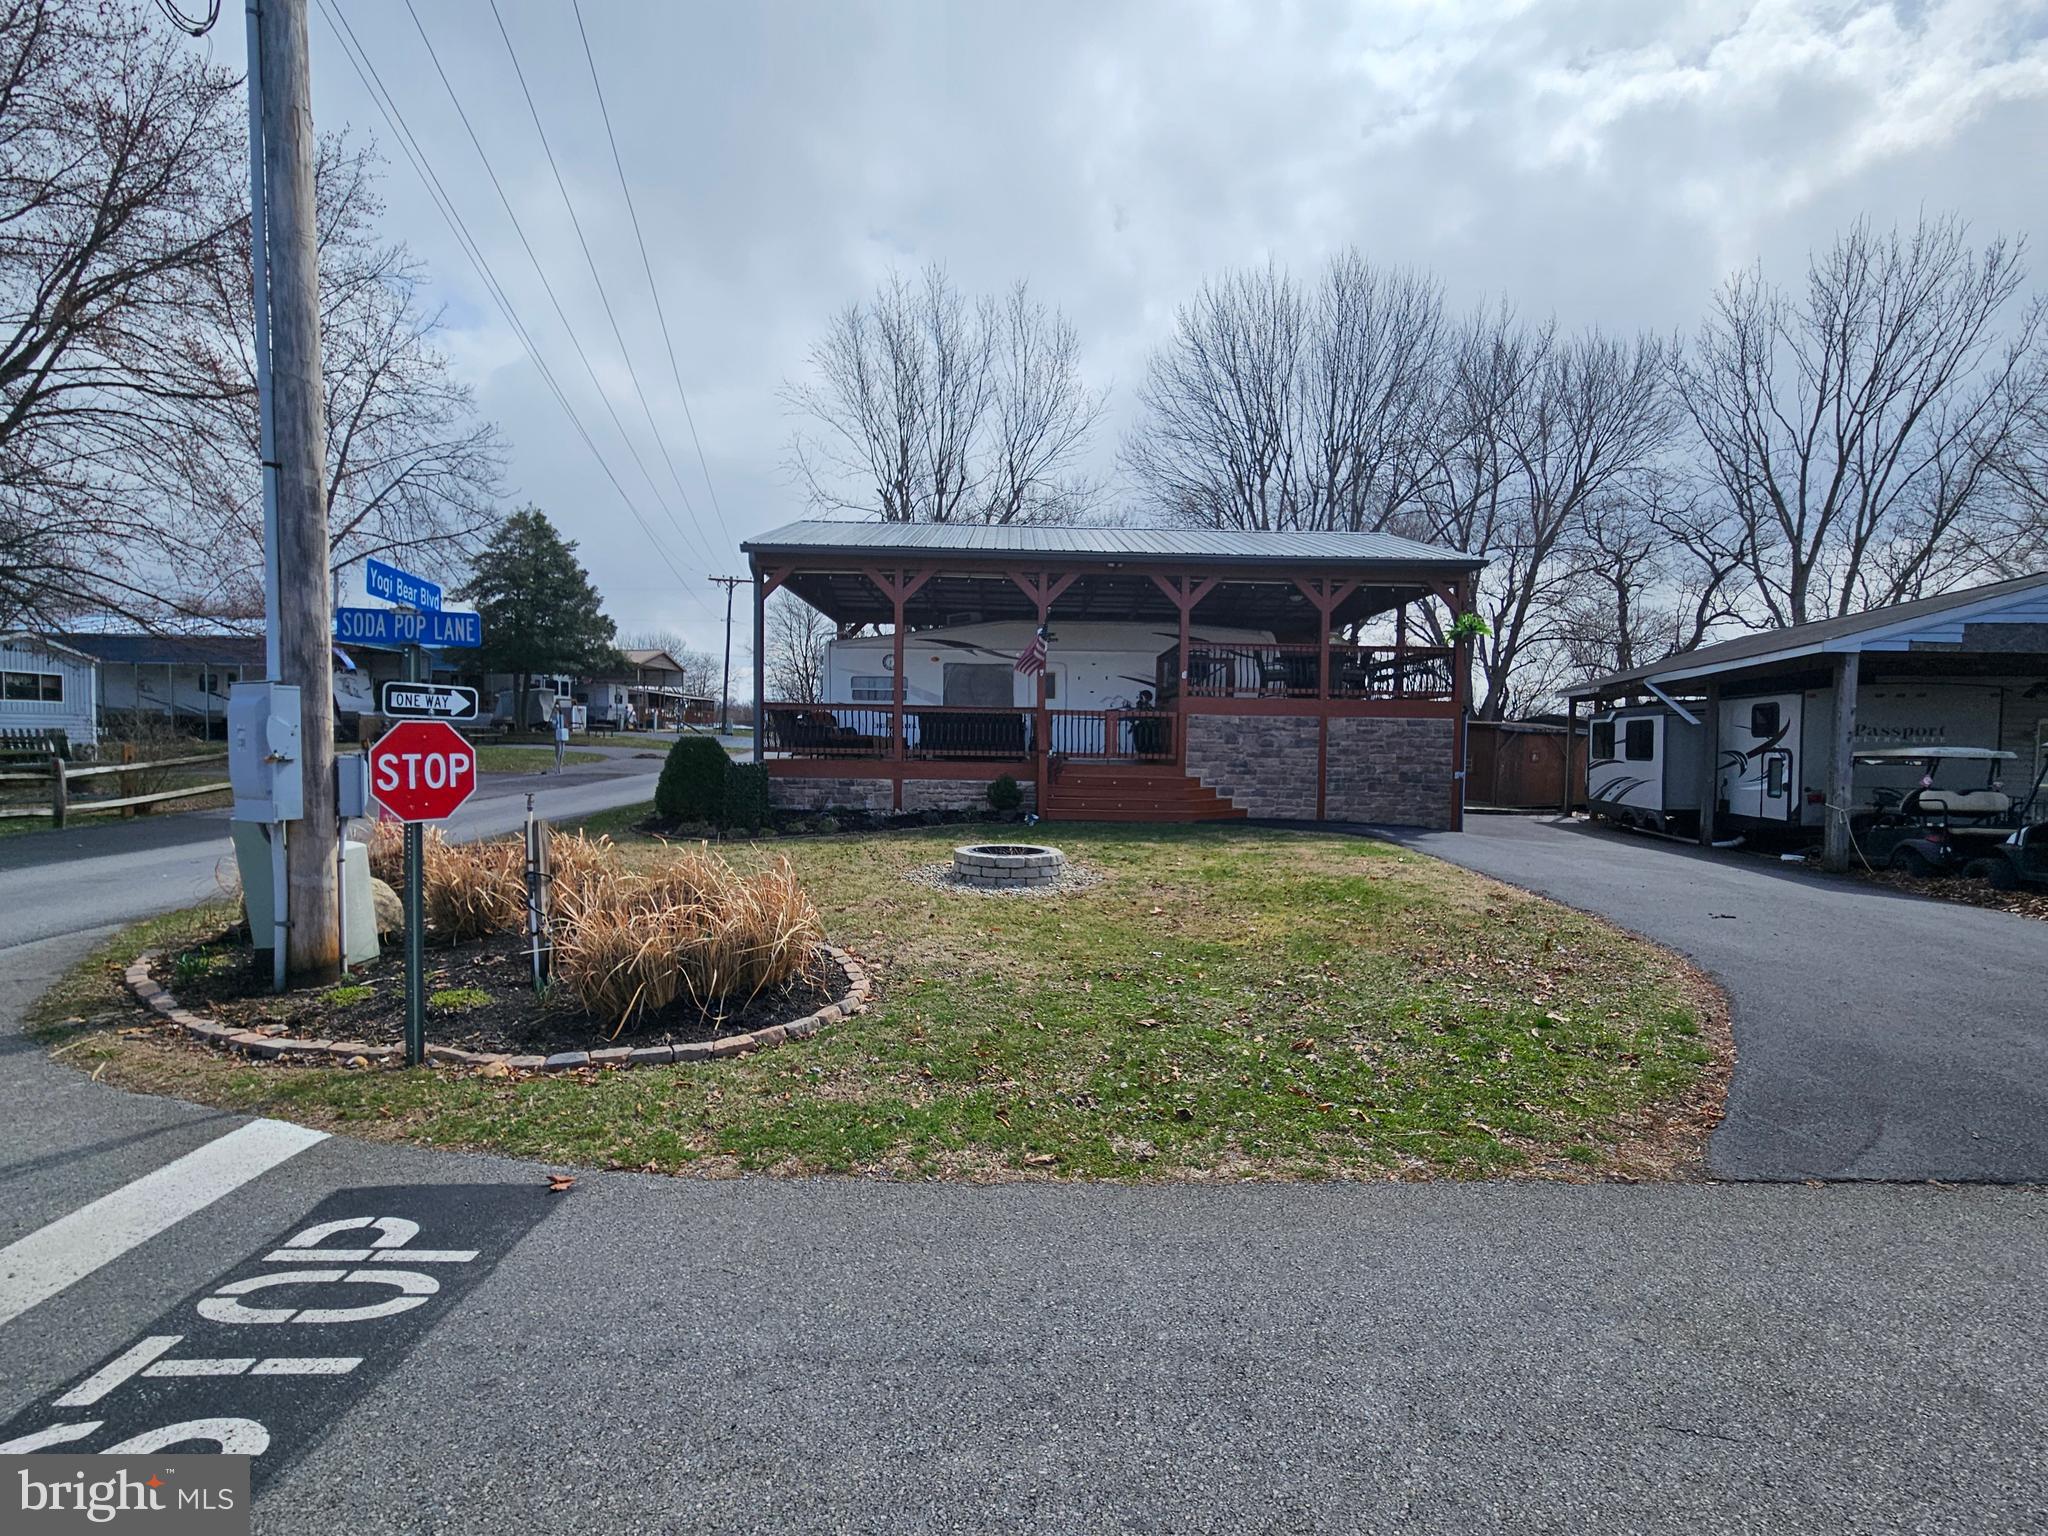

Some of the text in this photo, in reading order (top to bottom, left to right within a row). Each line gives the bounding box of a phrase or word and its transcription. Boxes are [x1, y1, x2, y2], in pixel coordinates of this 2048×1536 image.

[370, 567, 440, 610] Yogi Bear Blvd
[342, 612, 475, 642] SODA POP LANE
[396, 693, 449, 709] ONE WAY
[1855, 724, 1946, 739] Passport
[377, 752, 470, 791] STOP
